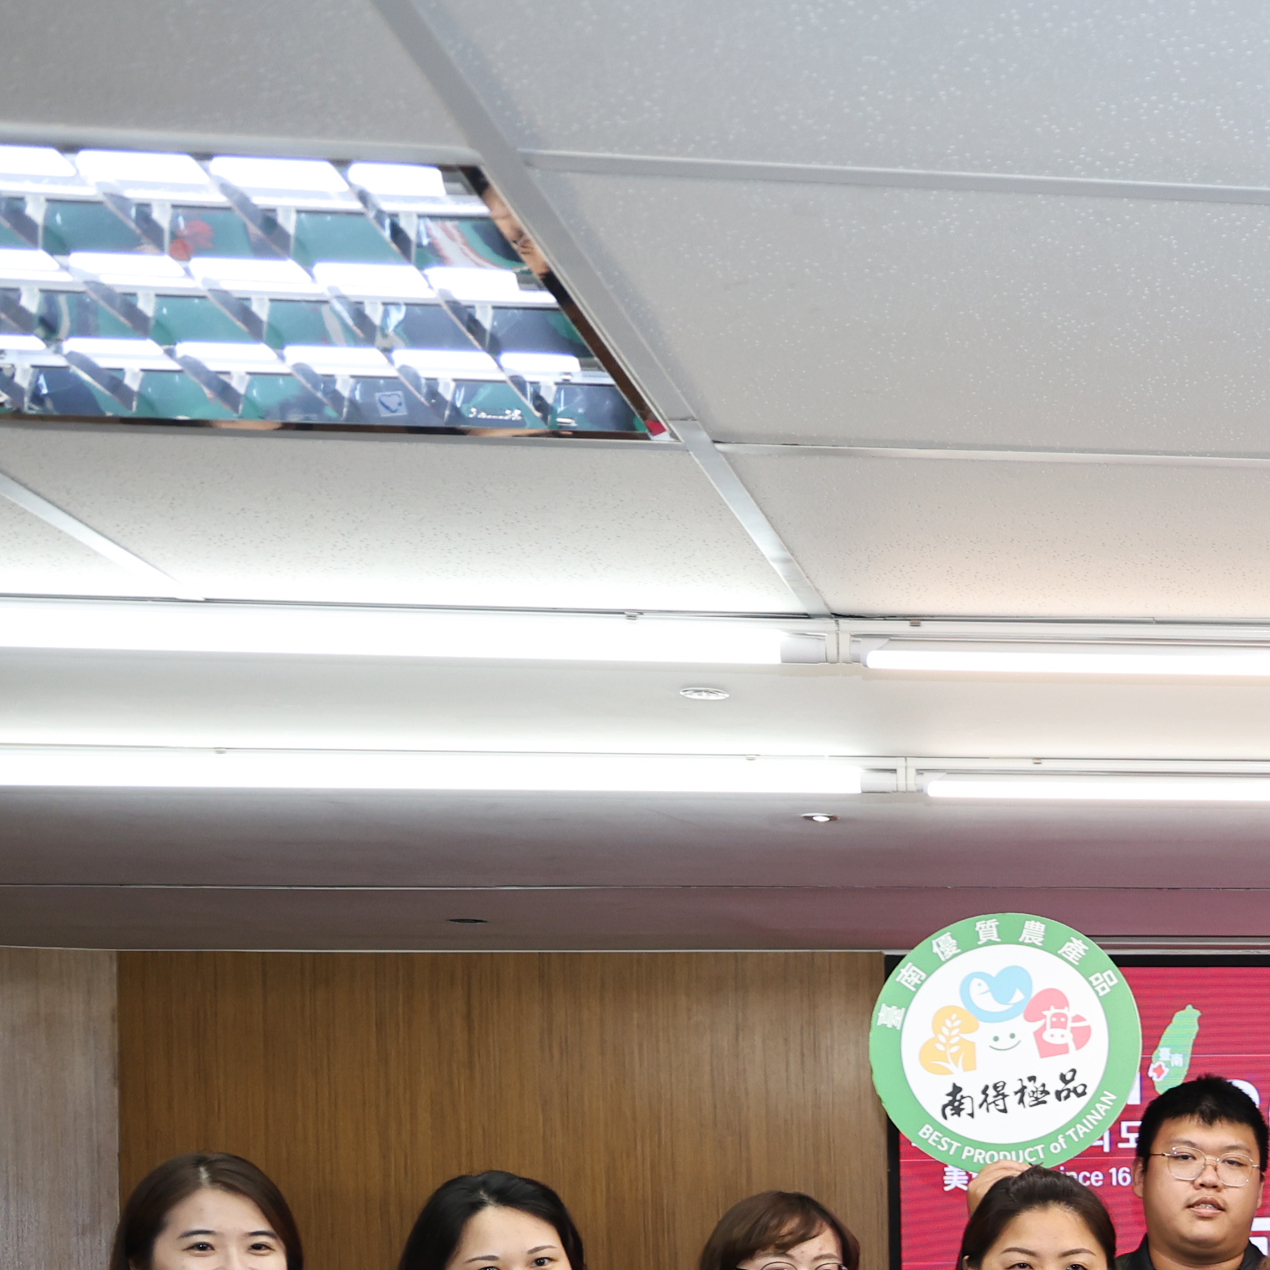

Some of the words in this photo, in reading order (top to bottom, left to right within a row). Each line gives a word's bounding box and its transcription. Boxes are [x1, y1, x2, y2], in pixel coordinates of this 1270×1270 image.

[877, 918, 1119, 1030] 臺南優質農產品
[918, 1124, 960, 1155] BEST
[961, 1145, 1046, 1167] PRODUCT
[1050, 1135, 1068, 1154] of
[1064, 1090, 1118, 1143] TAINAN
[941, 1068, 1088, 1120] 南得極品
